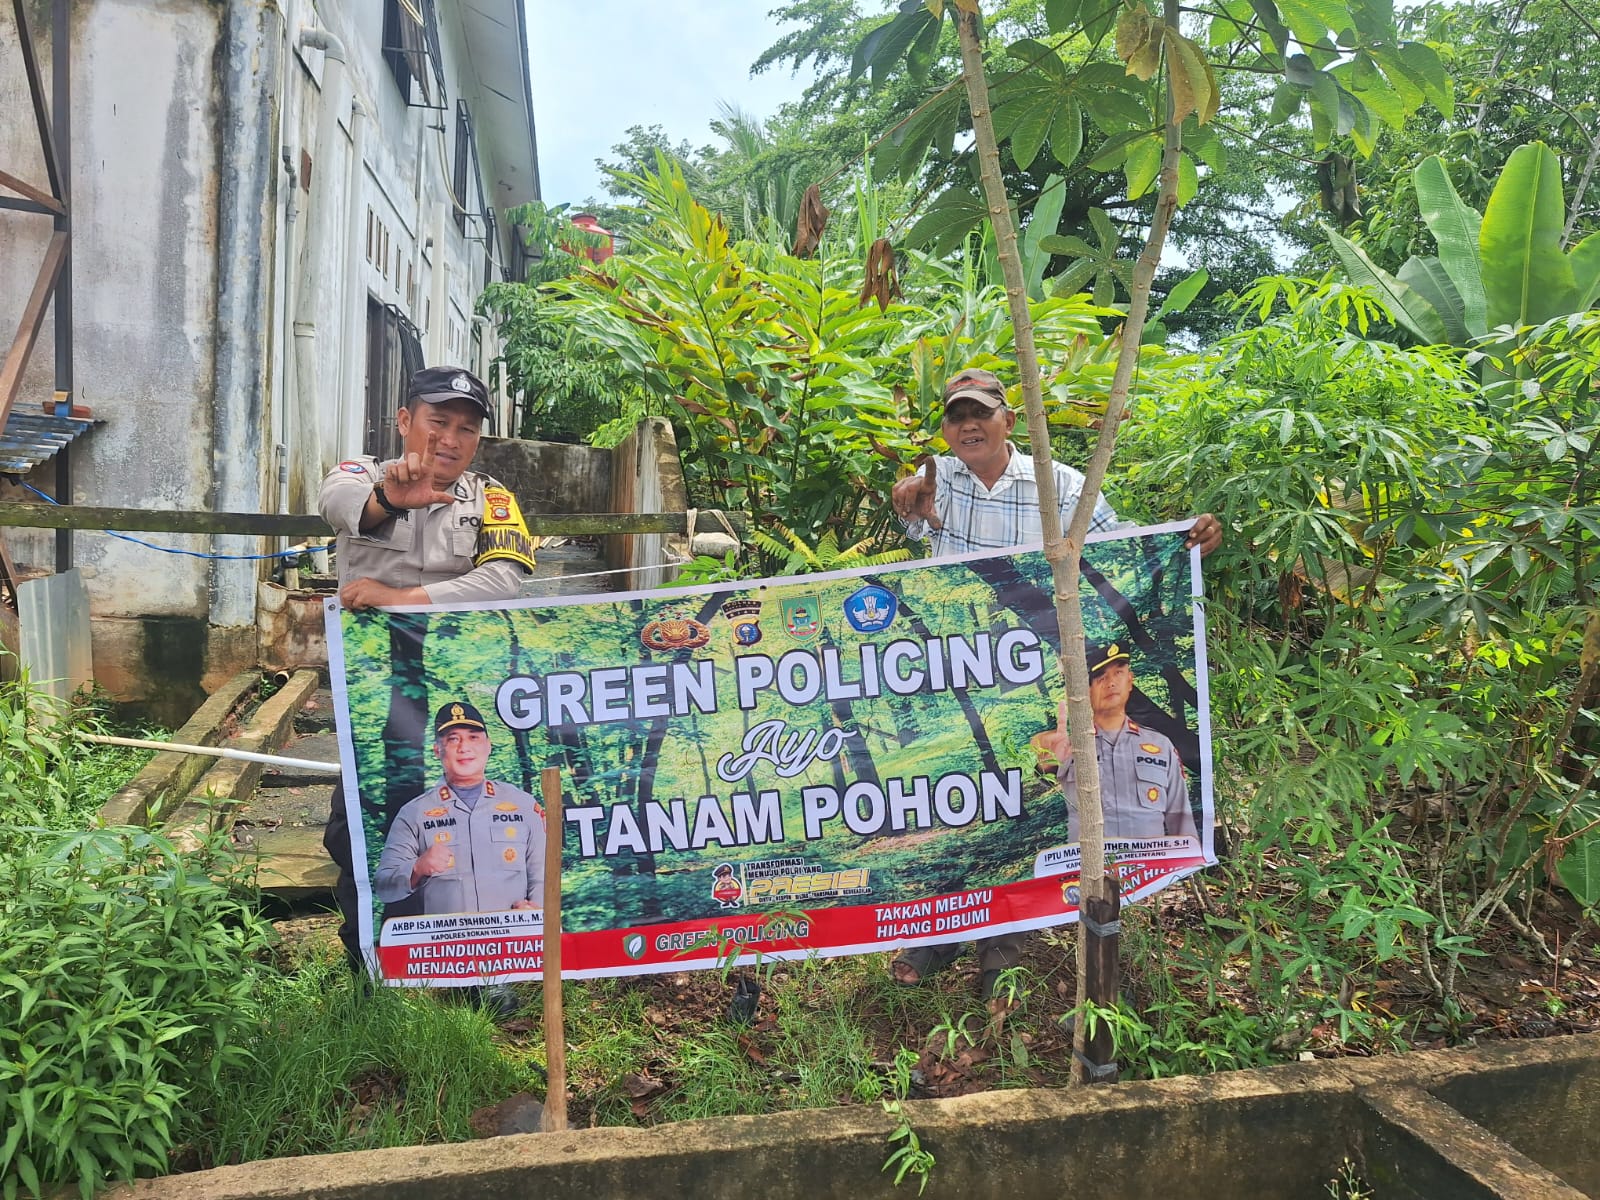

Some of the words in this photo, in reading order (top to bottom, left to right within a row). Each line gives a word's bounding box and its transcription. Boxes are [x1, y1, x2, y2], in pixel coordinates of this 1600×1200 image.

[496, 659, 717, 730] GREEN
[736, 629, 1044, 709] POLICING
[717, 720, 857, 782] Ayo
[1136, 756, 1167, 768] POLRI
[492, 814, 524, 823] POLRI
[564, 789, 784, 857] TANAM
[801, 767, 1022, 841] POHON
[423, 820, 436, 830] ISA
[437, 818, 457, 829] IMAM
[1044, 851, 1061, 862] IPTU
[803, 865, 822, 874] YANG
[875, 902, 932, 922] TAKKAN
[935, 889, 992, 914] MELAYU
[391, 921, 415, 931] AKBP
[416, 920, 431, 930] ISA
[433, 918, 457, 928] IMAM
[531, 913, 545, 922] M.
[876, 920, 931, 938] HILANG
[935, 907, 990, 932] DIBUMI
[431, 931, 466, 941] KAPOLRES
[409, 942, 501, 959] MELINDUNGI
[505, 939, 544, 954] TUAH
[407, 960, 476, 975] MENJAGA
